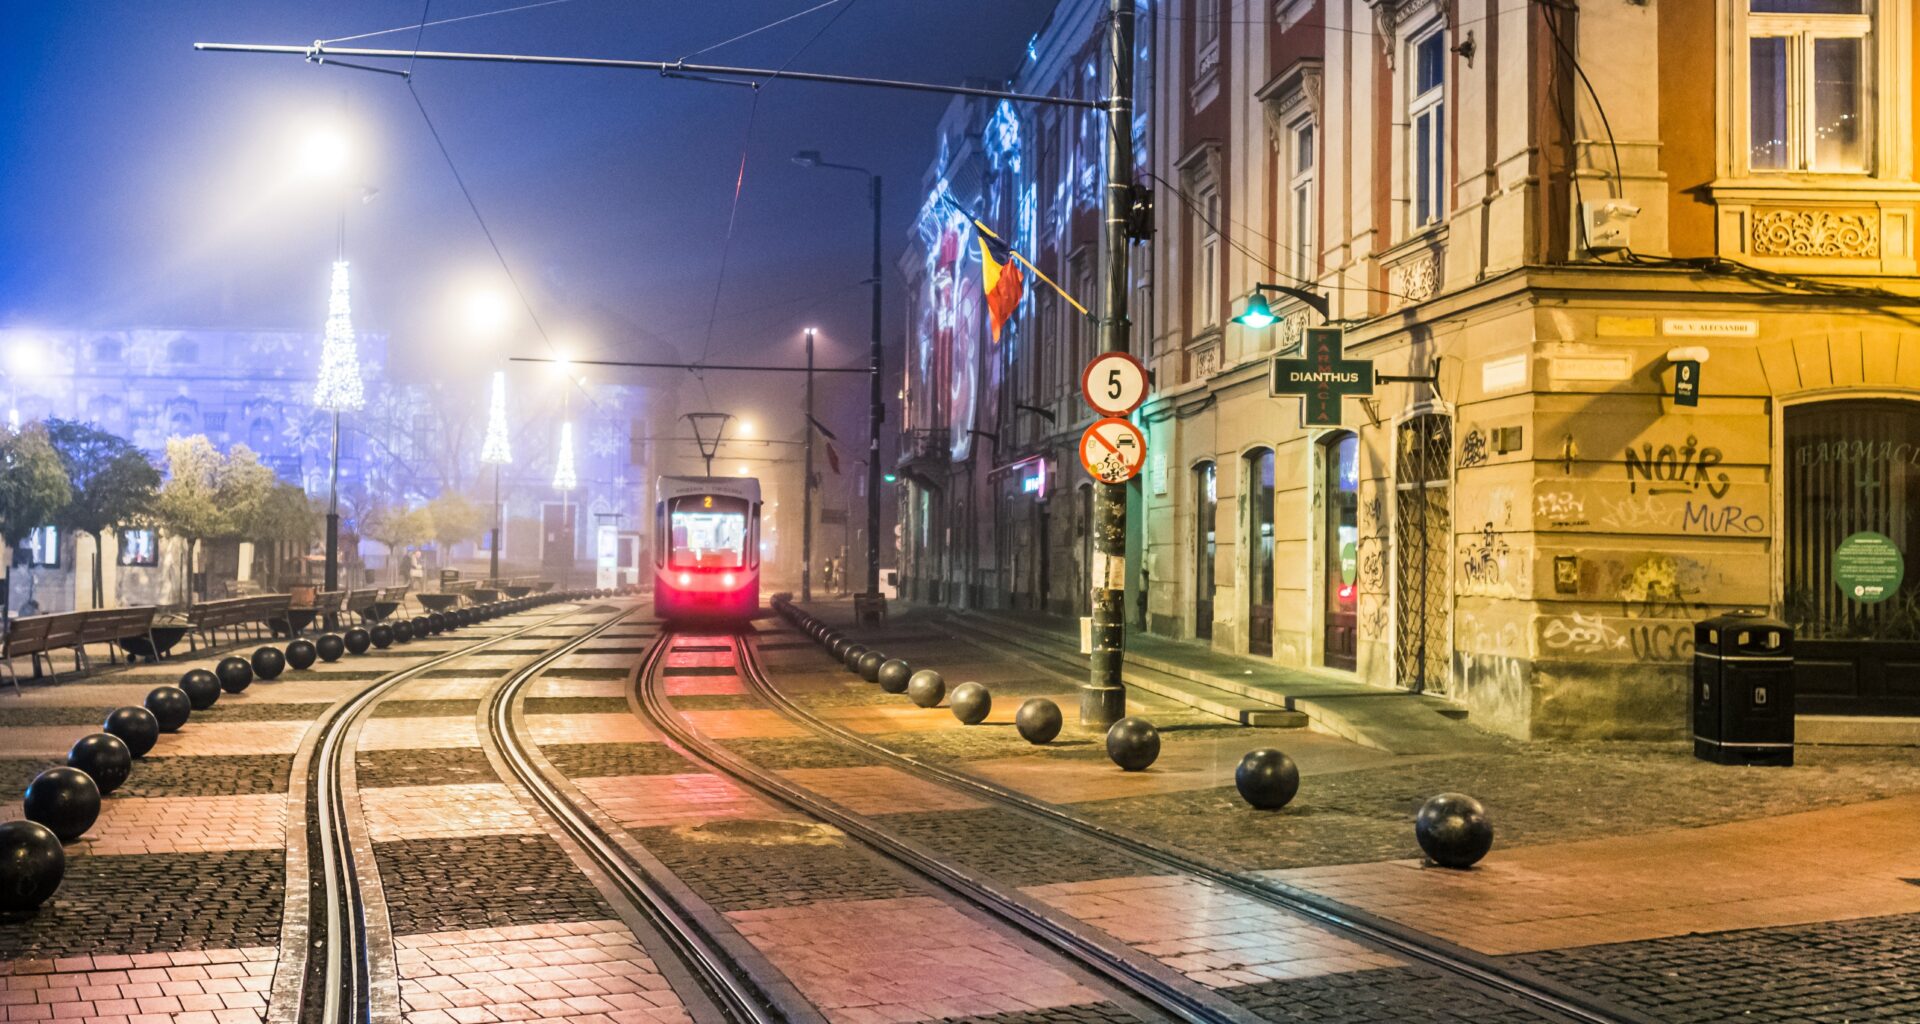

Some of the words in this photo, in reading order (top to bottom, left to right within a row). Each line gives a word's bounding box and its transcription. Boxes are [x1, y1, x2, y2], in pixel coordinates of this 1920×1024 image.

[1107, 369, 1122, 400] 5
[1290, 371, 1360, 383] DIANTHUS
[703, 495, 713, 509] 2
[1682, 500, 1765, 534] MURO
